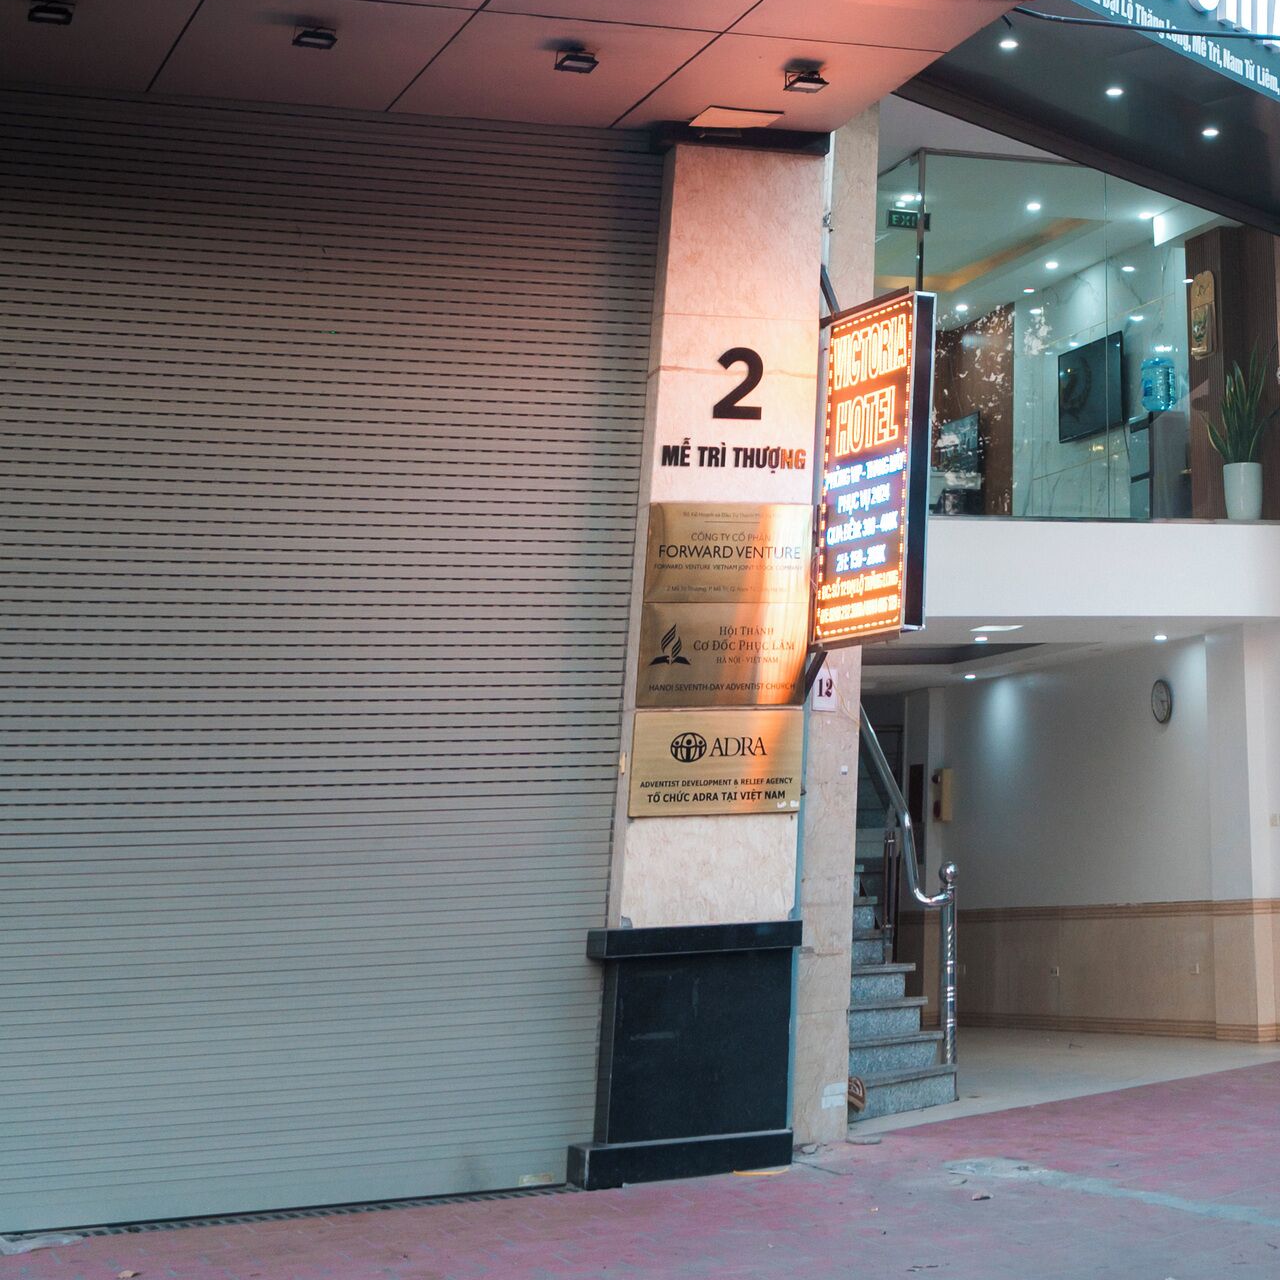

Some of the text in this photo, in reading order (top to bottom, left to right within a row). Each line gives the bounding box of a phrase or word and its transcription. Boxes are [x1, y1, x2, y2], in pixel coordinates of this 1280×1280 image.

[1223, 47, 1244, 76] Nam
[833, 313, 907, 390] VICTORIA
[712, 347, 764, 420] 2
[835, 385, 899, 457] HOTEL
[661, 438, 807, 474] MỄ TRÌ THƯỢNG
[691, 530, 718, 542] CÔNG
[721, 532, 730, 542] TY
[658, 544, 801, 559] FORWARD VENTURE
[675, 683, 724, 691] SEVENTH-DAY
[817, 678, 833, 697] 12
[709, 737, 767, 757] ADRA
[640, 780, 679, 788] ADVENTIST
[682, 779, 731, 787] DEVELOPMENT
[766, 777, 793, 785] AGENCY
[647, 789, 785, 803] TỔ CHỨC ADRA TẠI VIỆT NAM
